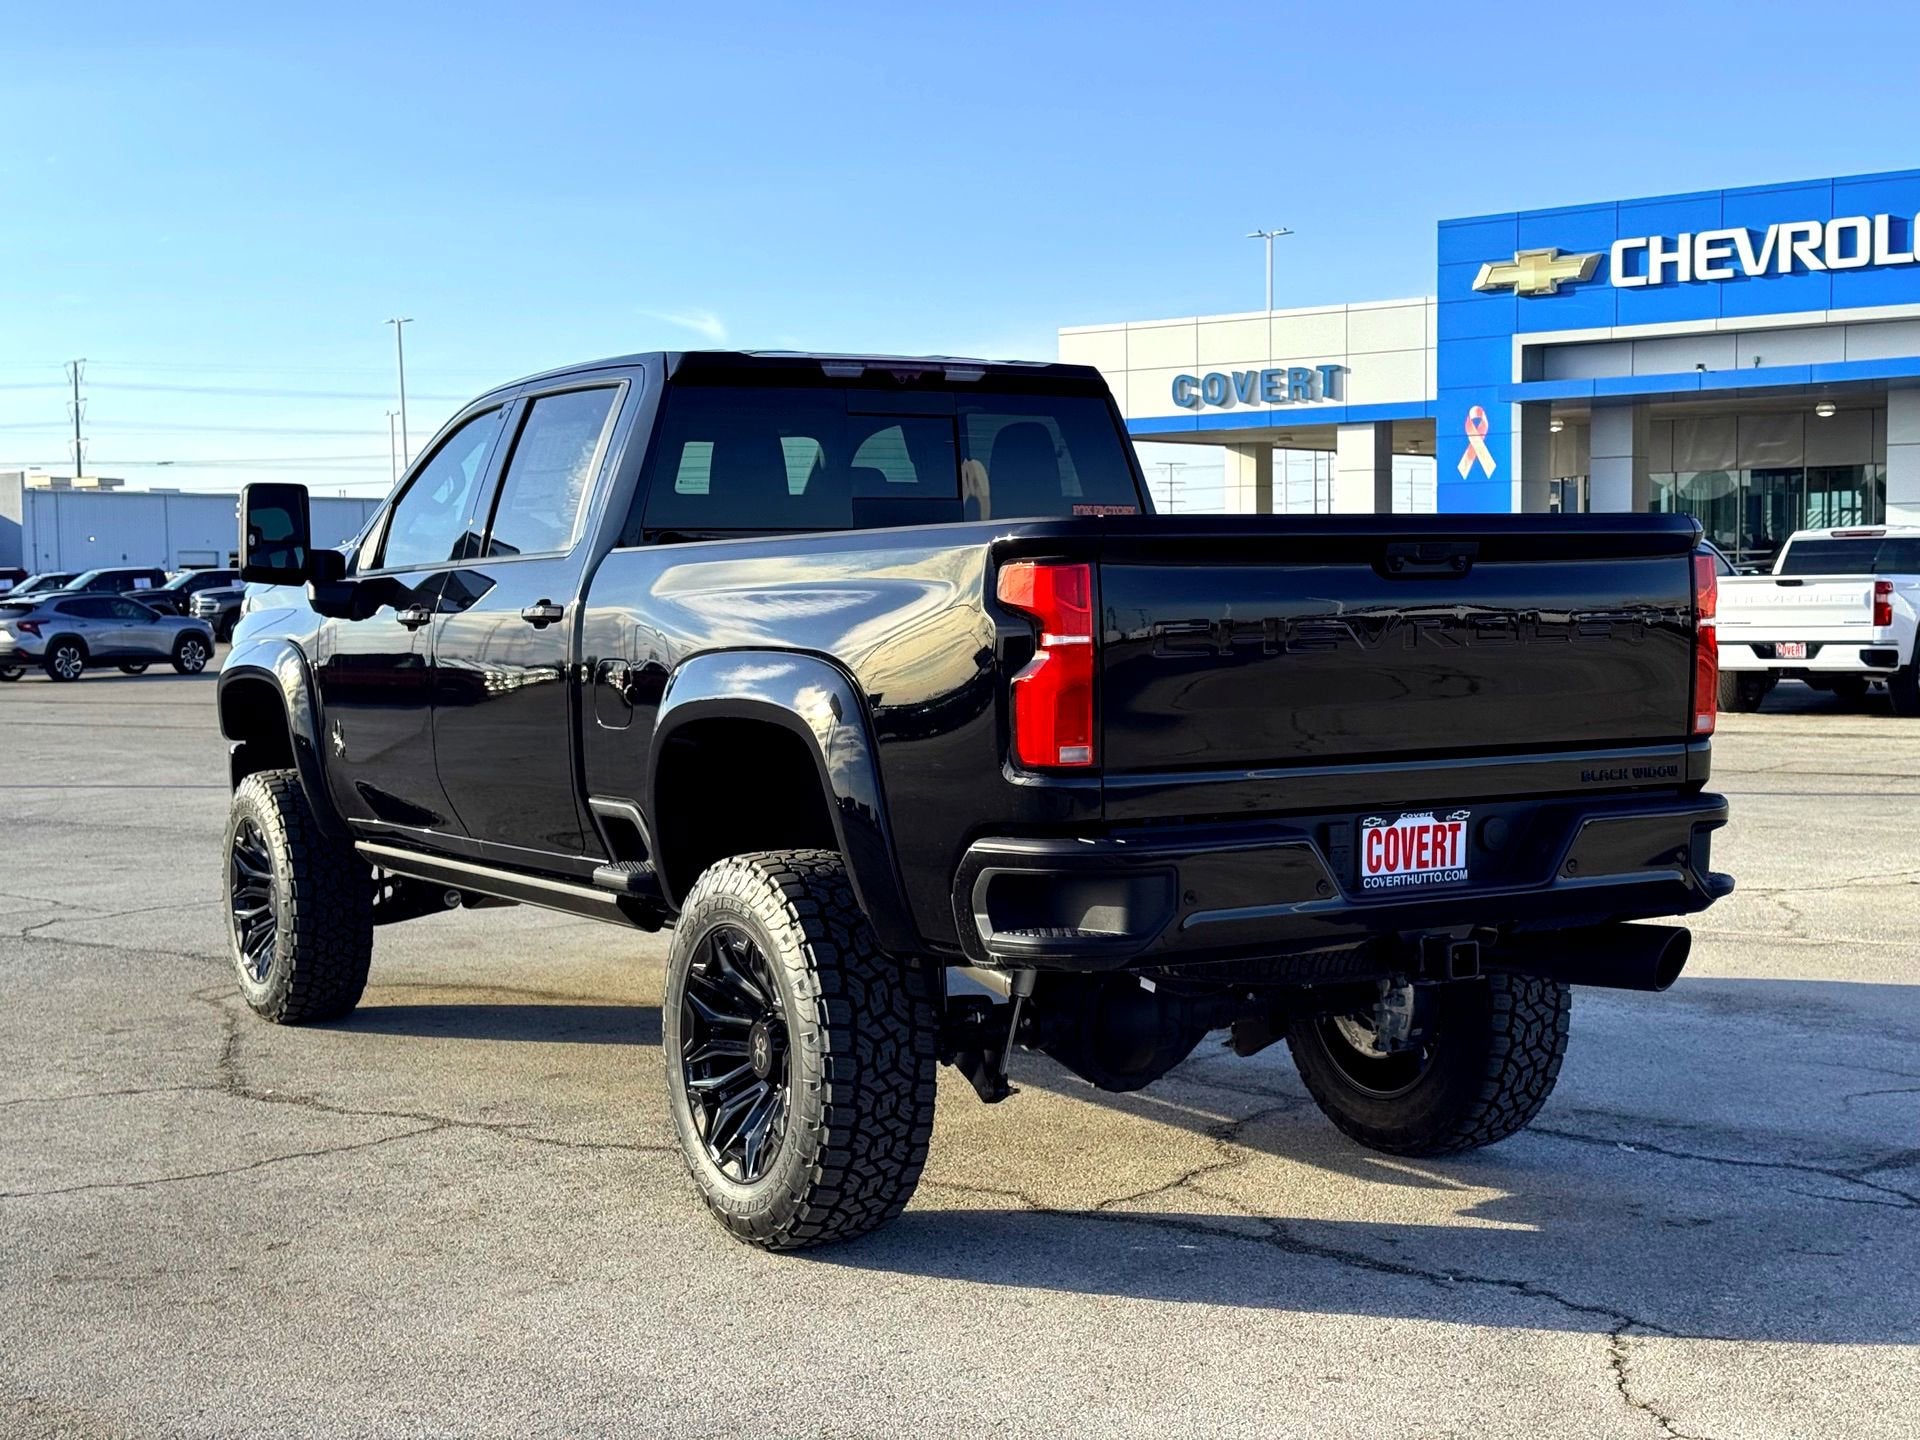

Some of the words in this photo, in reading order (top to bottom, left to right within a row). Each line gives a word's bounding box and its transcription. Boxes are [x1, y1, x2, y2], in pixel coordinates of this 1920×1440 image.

[1610, 212, 1920, 288] CHEVROL
[1171, 364, 1344, 408] COVERT
[1153, 608, 1662, 658] CHEVROLET
[1581, 767, 1628, 782] BLACK
[1632, 765, 1678, 778] WIDOW
[1366, 823, 1461, 874] COVERT
[1363, 869, 1468, 889] COVERTHUTTO.COM
